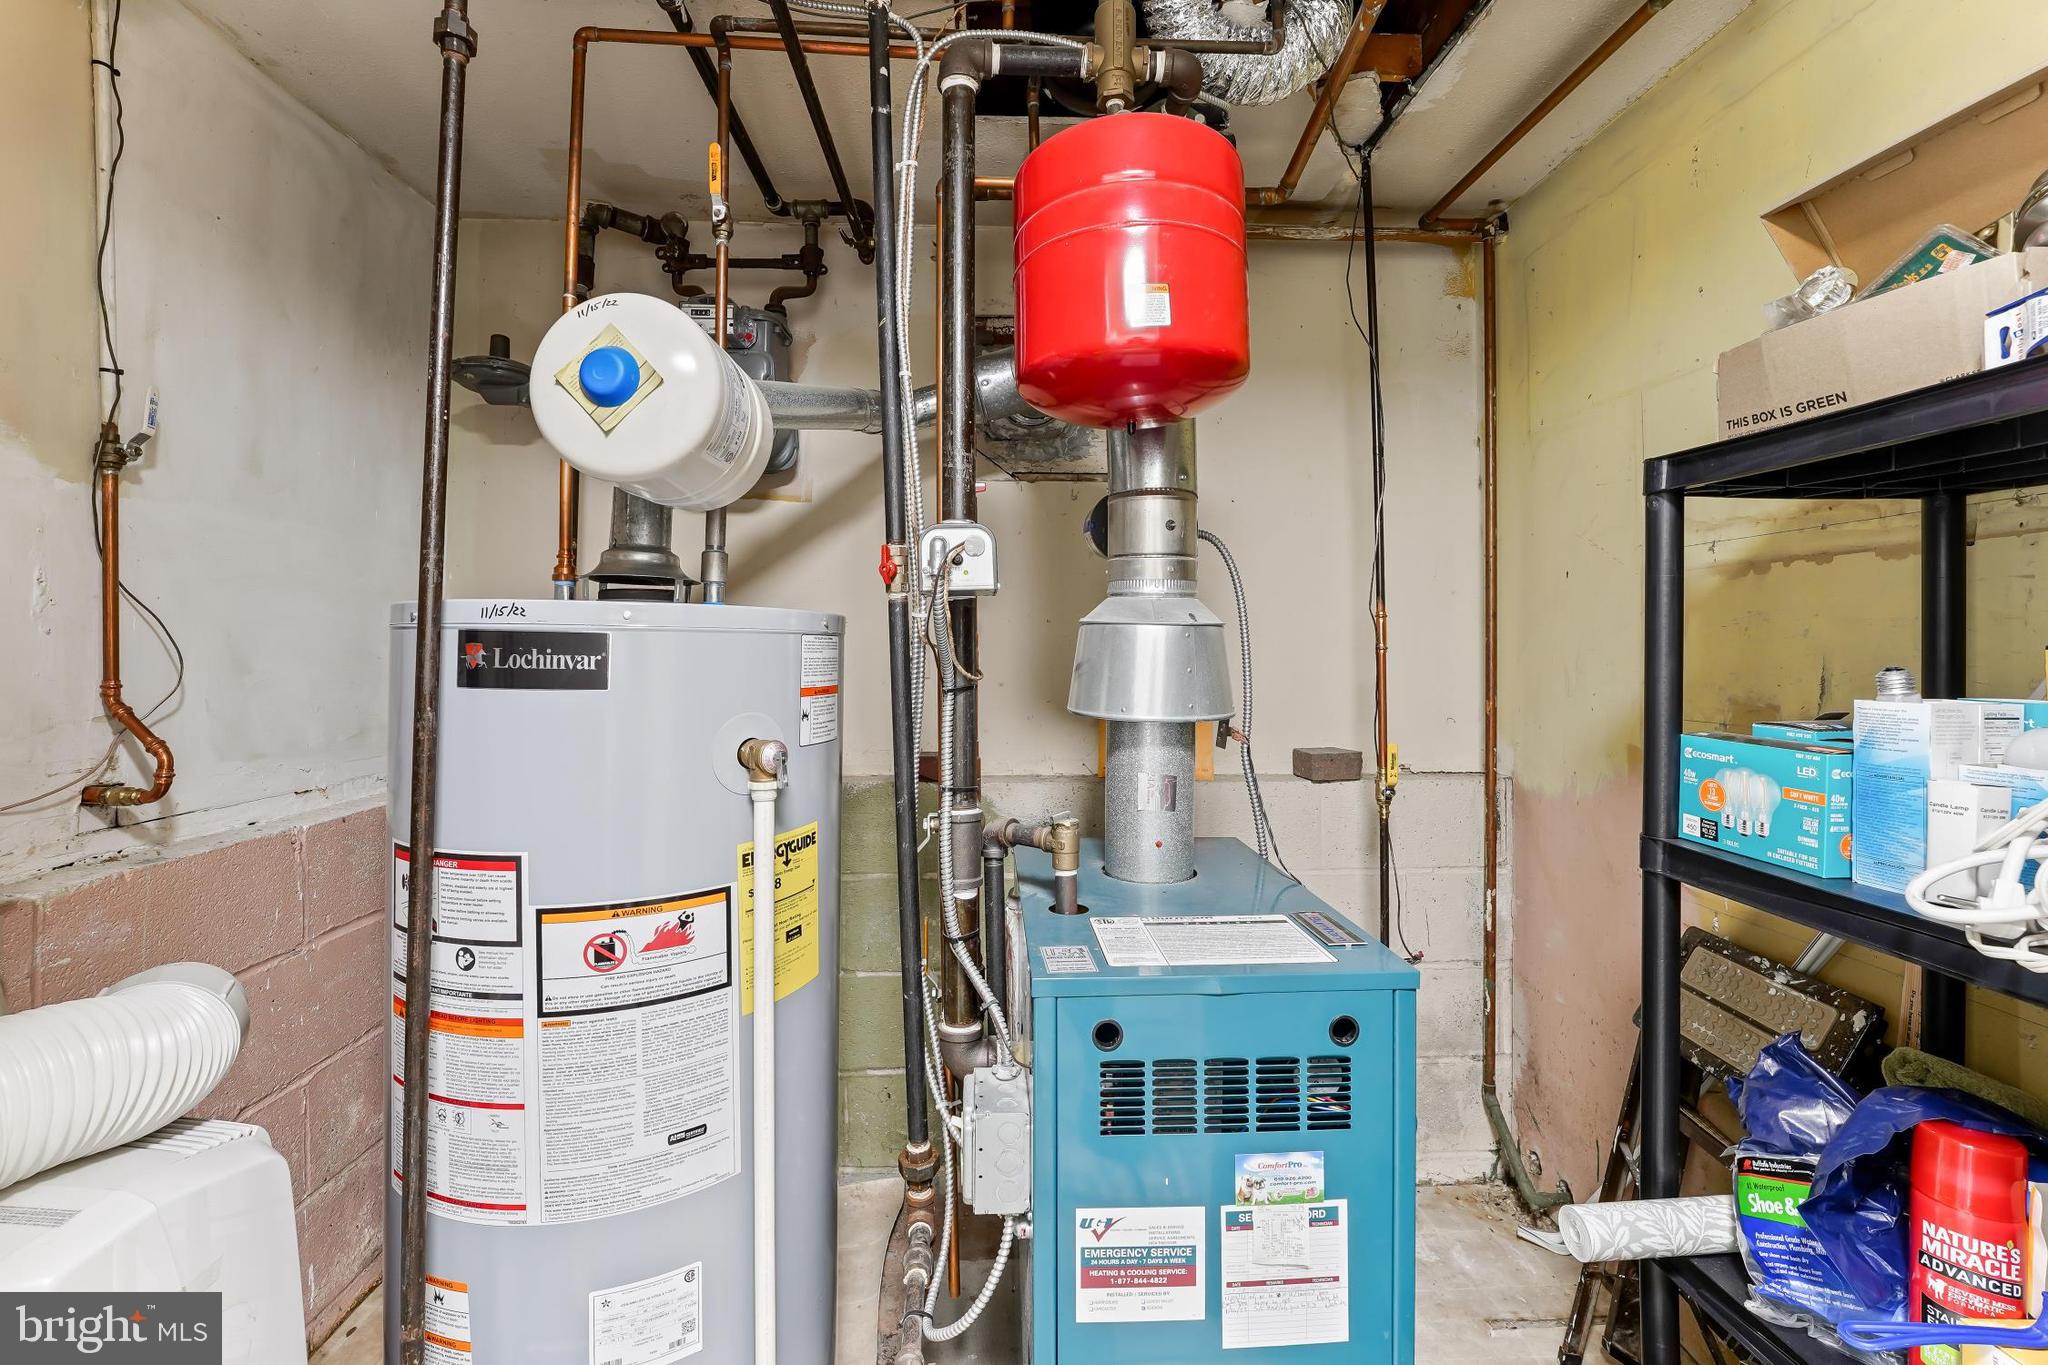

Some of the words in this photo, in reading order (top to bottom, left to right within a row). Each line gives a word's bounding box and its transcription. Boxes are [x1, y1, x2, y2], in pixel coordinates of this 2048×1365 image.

[577, 298, 619, 318] 11/15/22
[1726, 416, 1749, 430] THIS
[1752, 409, 1777, 425] BOX
[1780, 406, 1793, 418] IS
[1796, 391, 1848, 413] GREEN
[481, 602, 526, 619] 11/15/22
[493, 647, 602, 671] Lochinvar
[1692, 750, 1735, 764] ecosmart
[1797, 765, 1816, 777] LED
[1950, 803, 1969, 811] Lamp
[621, 905, 663, 917] WARNING
[1258, 1160, 1302, 1170] ComfortPro
[1753, 1184, 1785, 1192] Waterproof
[1748, 1193, 1783, 1214] Shoe
[1785, 1197, 1798, 1216] &
[1922, 1219, 2020, 1264] NATURE'S
[1084, 1249, 1147, 1258] EMERGENCY
[1151, 1247, 1193, 1257] SERVICE
[1922, 1235, 2021, 1280] MIRACLE
[1920, 1254, 2021, 1297] ADVANCED
[1948, 1285, 1990, 1304] SEVERE
[1992, 1300, 2016, 1312] MESS
[1948, 1297, 1996, 1318] FORMULA
